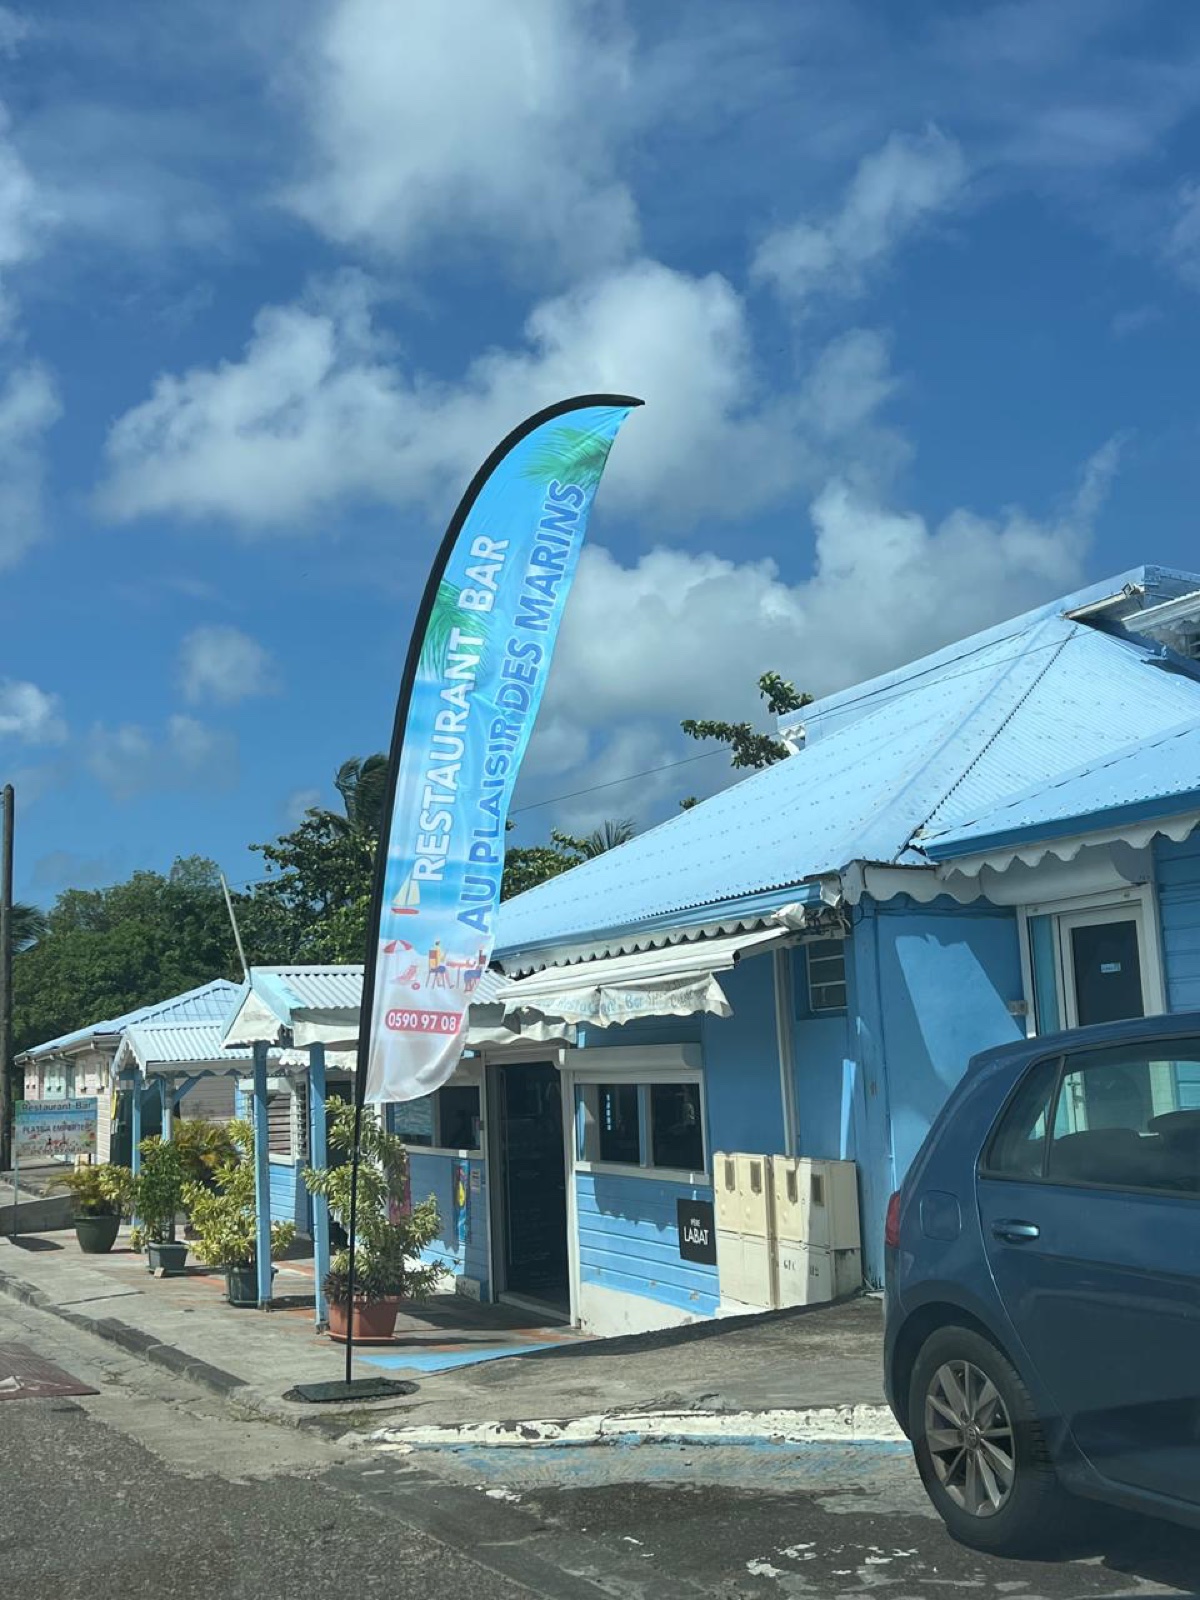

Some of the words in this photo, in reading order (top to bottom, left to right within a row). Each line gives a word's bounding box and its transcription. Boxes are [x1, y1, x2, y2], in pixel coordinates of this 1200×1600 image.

[514, 478, 587, 632] MARINS
[412, 627, 485, 882] RESTAURANT
[458, 534, 511, 613] BAR
[495, 637, 544, 713] DES
[468, 712, 522, 864] PLAISIR
[456, 874, 498, 934] AU
[388, 1011, 418, 1028] 0590
[421, 1014, 438, 1029] 97
[441, 1015, 457, 1031] 08
[683, 1225, 709, 1245] LABAT
